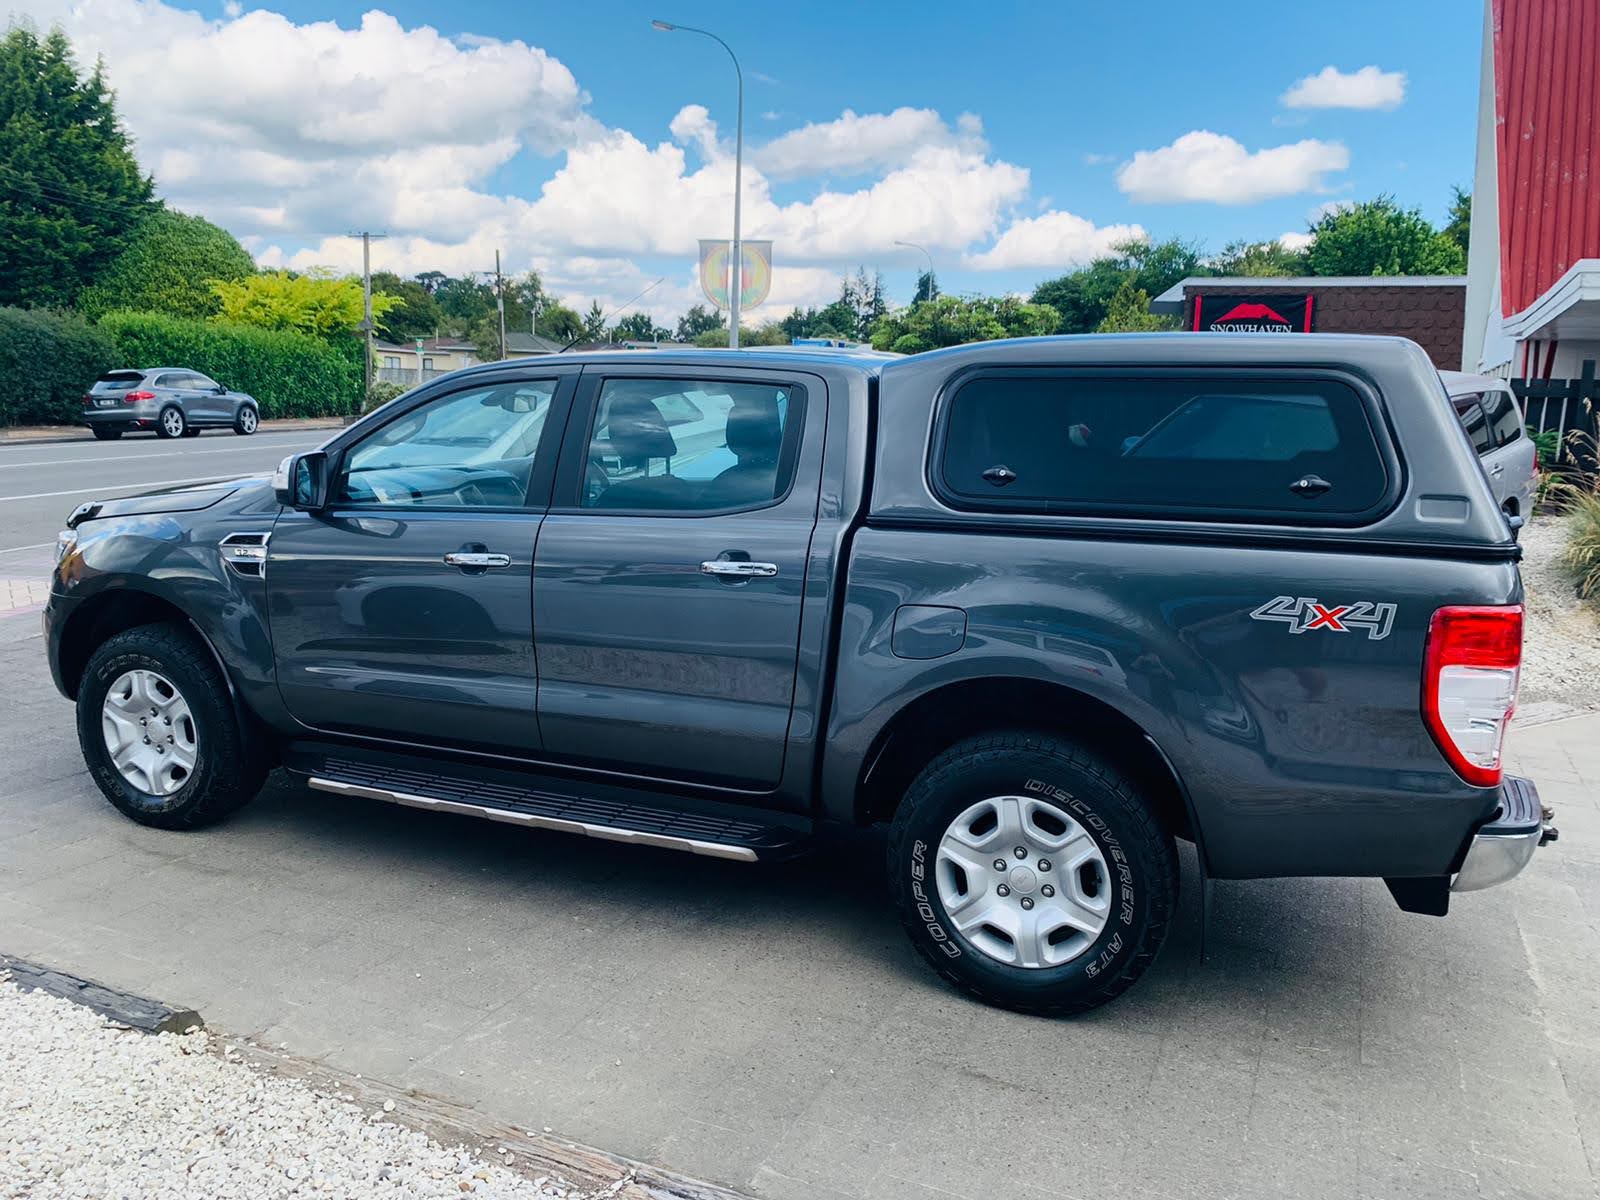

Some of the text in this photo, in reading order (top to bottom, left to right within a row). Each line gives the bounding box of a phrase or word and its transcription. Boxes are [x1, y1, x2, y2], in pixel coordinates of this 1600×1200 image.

[1209, 323, 1293, 333] SNOWHAVEN
[911, 840, 961, 959] COOPER
[1024, 779, 1134, 925] DISCOVERER
